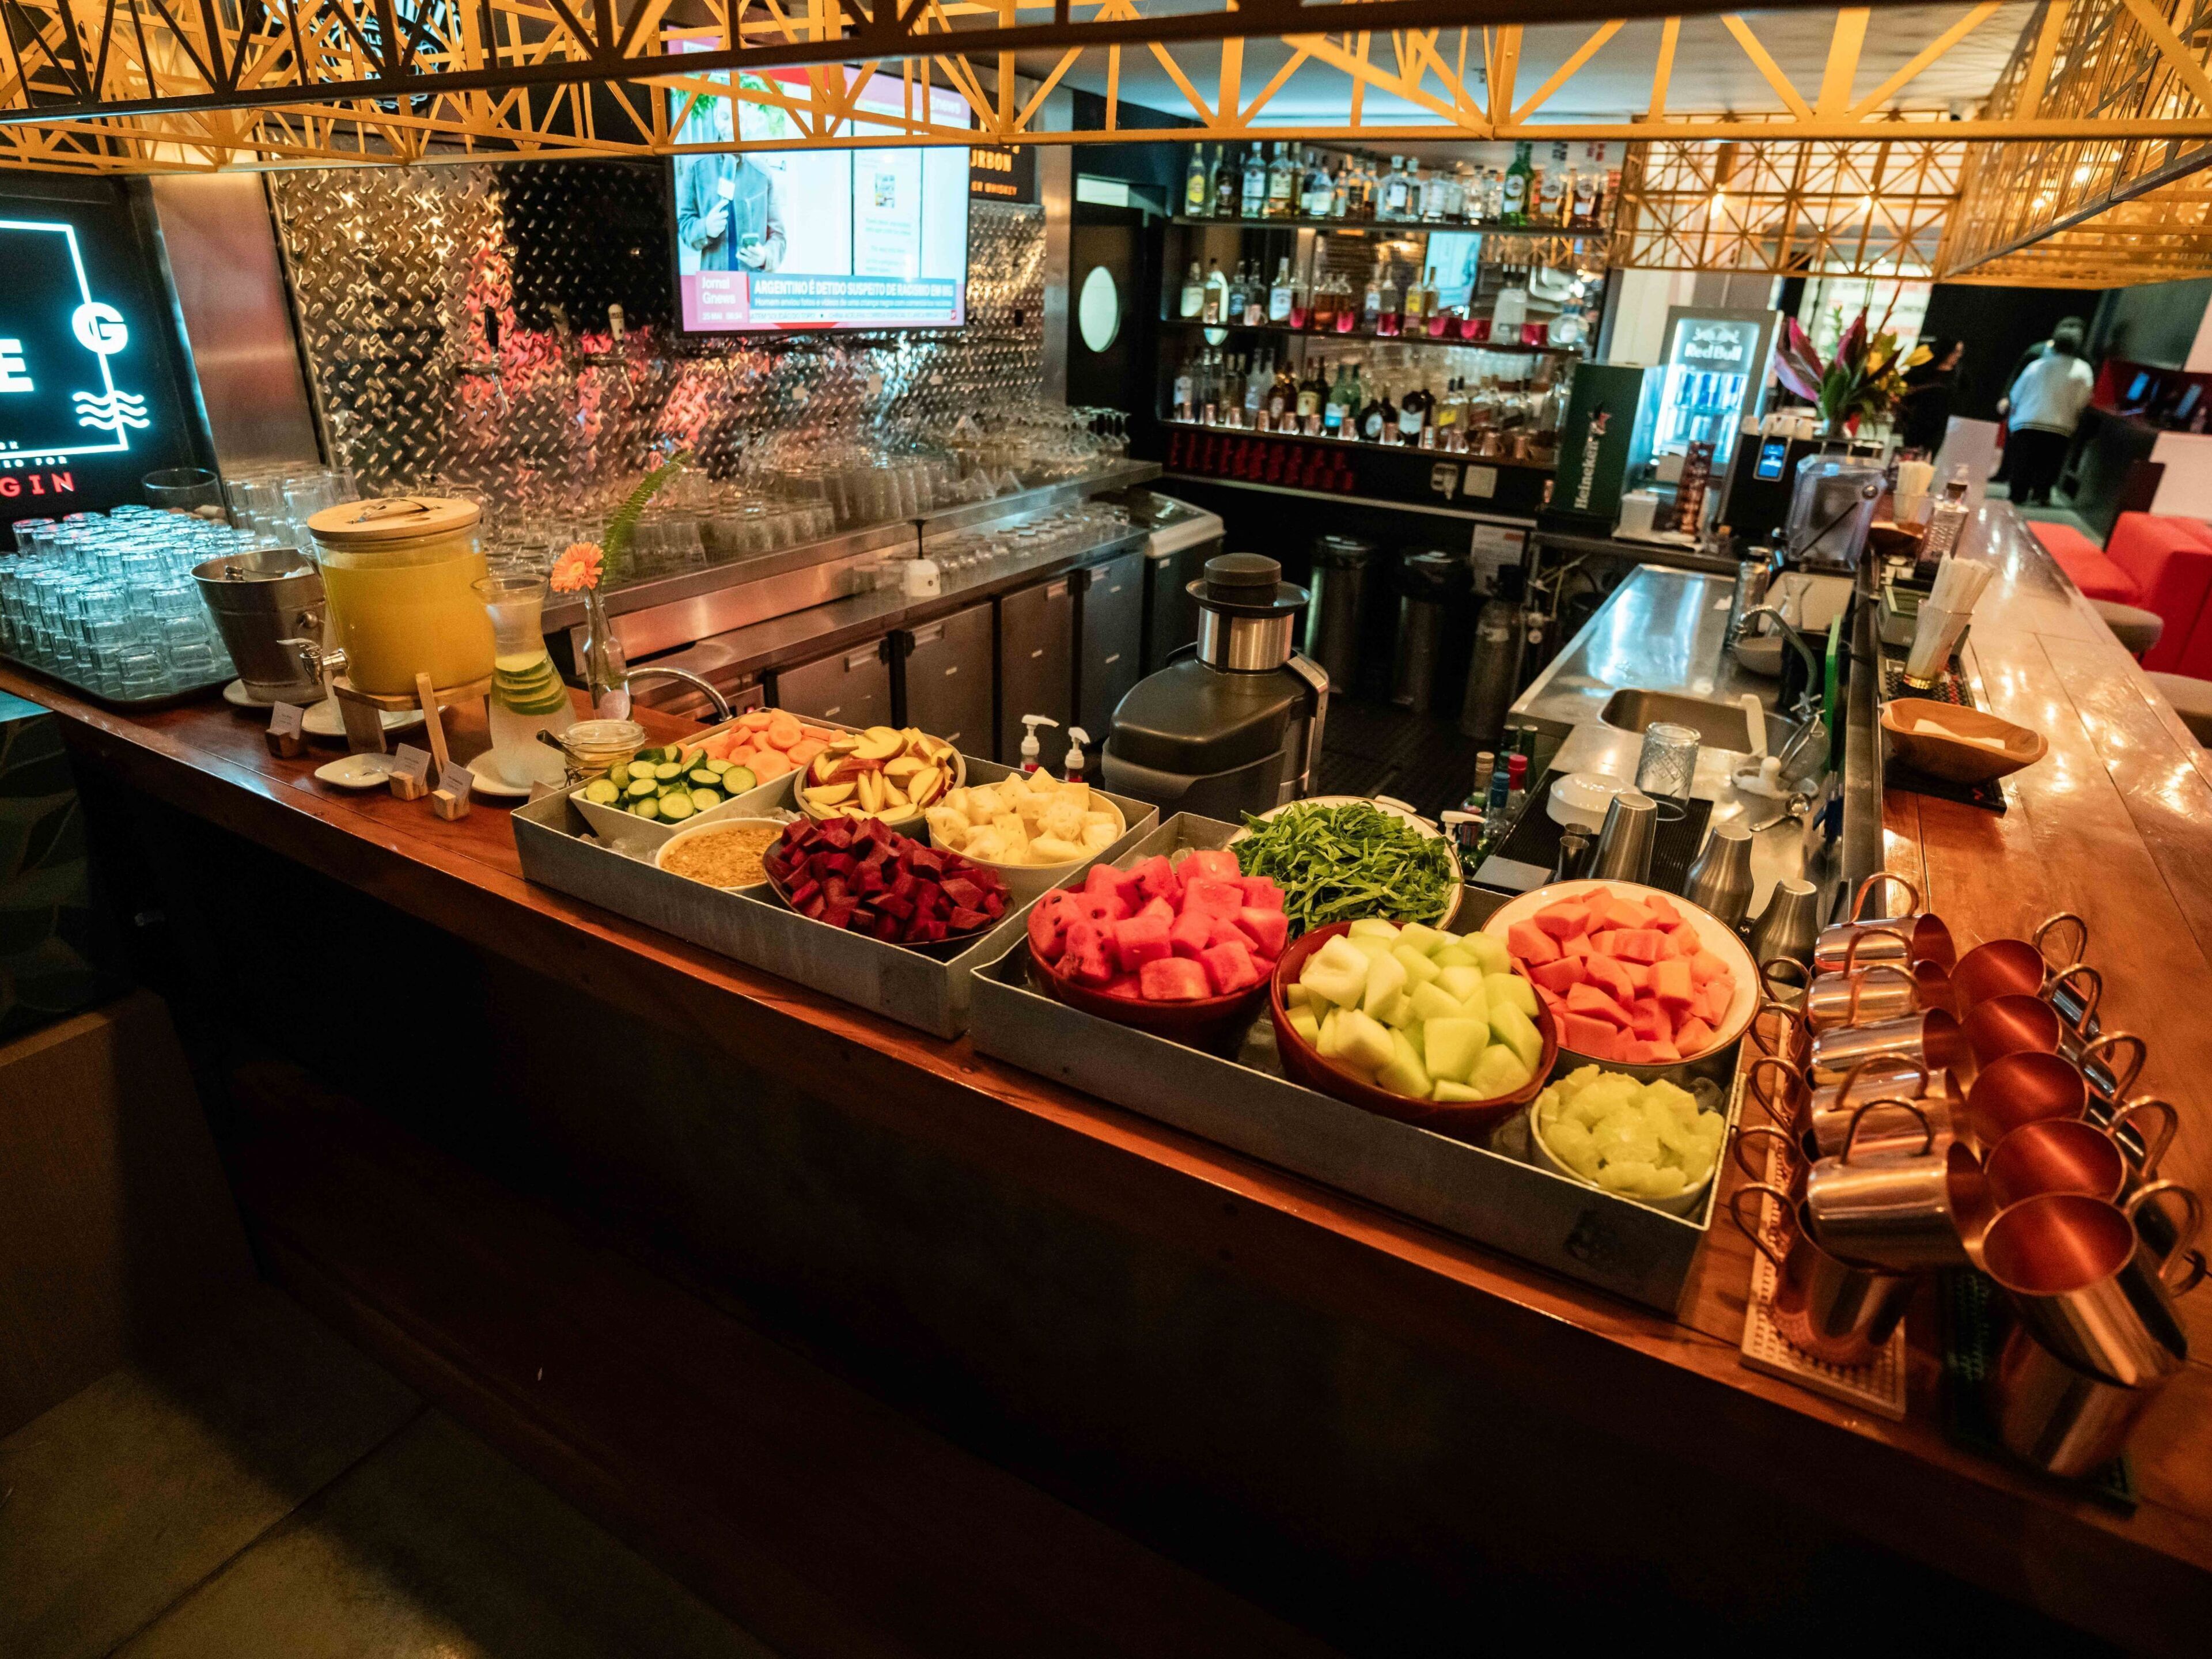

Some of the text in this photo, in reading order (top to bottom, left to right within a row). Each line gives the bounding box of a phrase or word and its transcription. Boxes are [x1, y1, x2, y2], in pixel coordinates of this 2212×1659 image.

[754, 280, 808, 295] ARGENTINO
[809, 279, 815, 295] É
[816, 282, 847, 296] DETIDO
[847, 282, 885, 296] SUSPEITO
[885, 283, 897, 296] DE
[897, 283, 930, 297] RACISMO
[1684, 342, 1743, 361] Red Bull
[35, 456, 67, 466] FOR
[0, 471, 74, 497] GIN
[1574, 440, 1599, 509] Heineken
